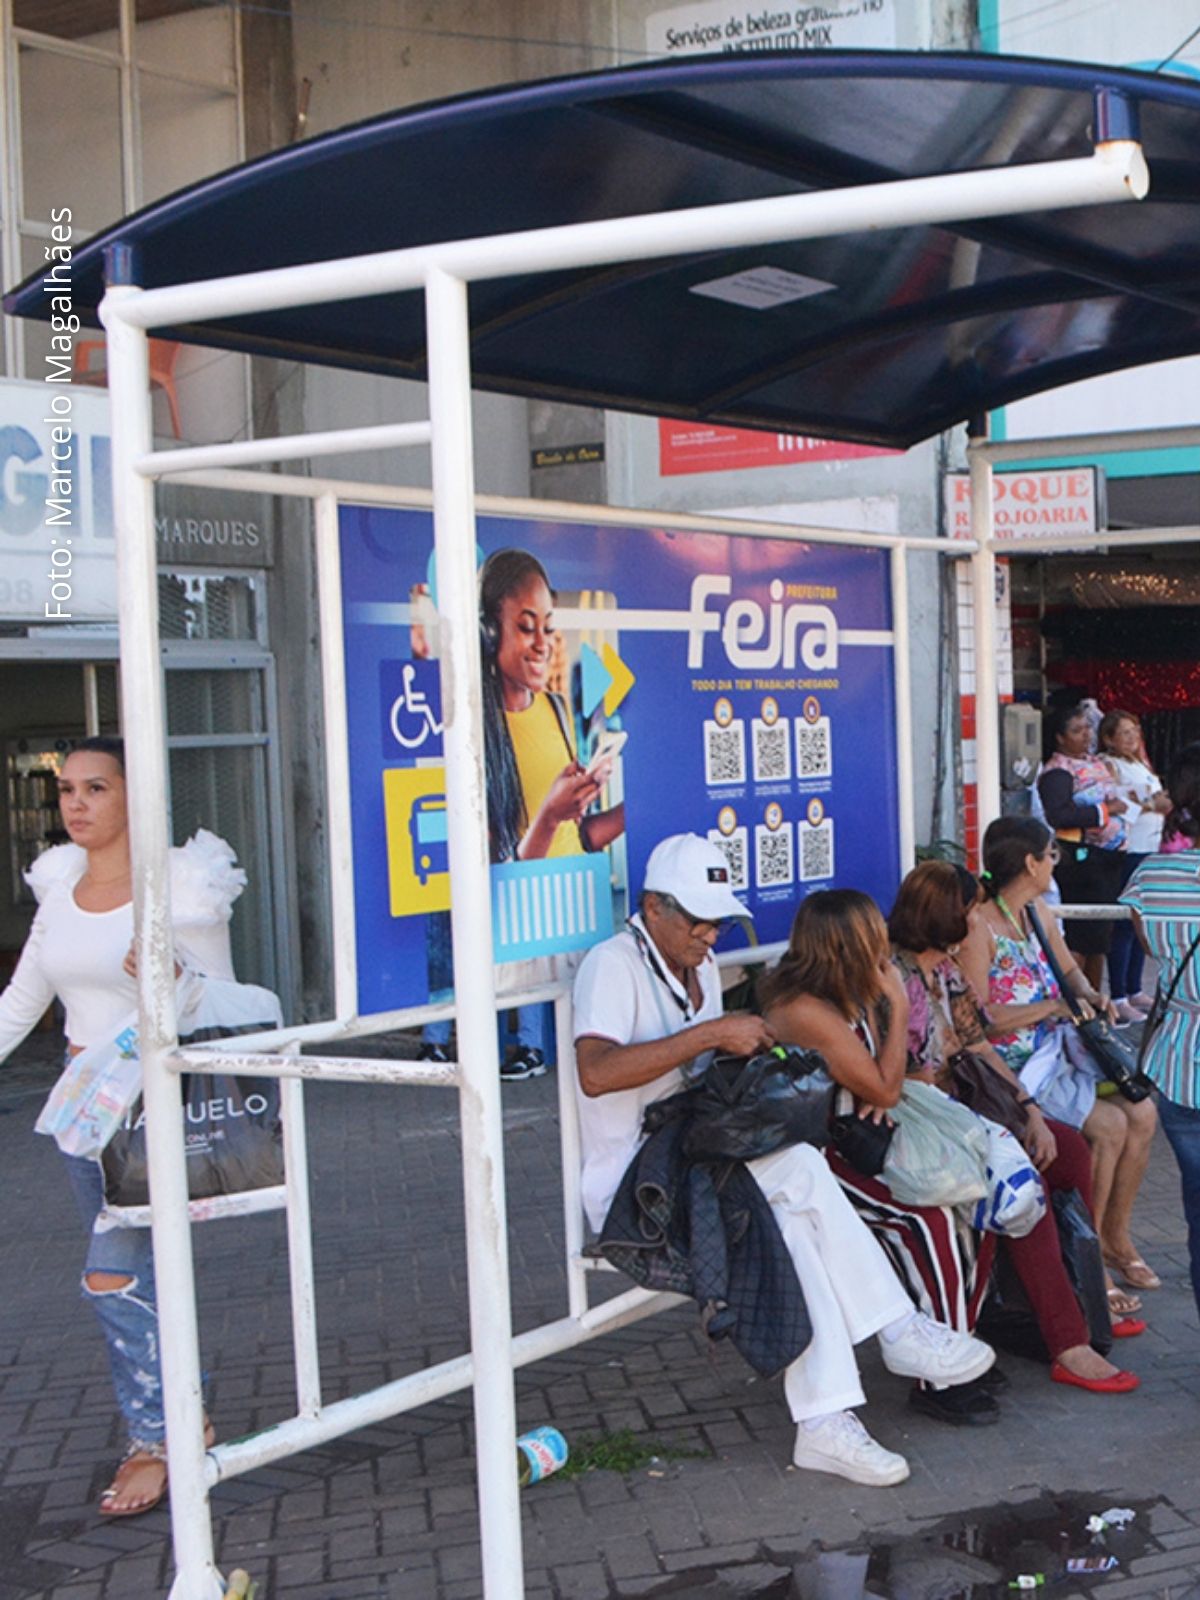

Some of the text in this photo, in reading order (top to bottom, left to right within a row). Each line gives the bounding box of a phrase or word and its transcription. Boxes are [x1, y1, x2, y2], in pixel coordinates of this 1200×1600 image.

[666, 21, 721, 50] Serviços
[725, 17, 743, 38] de
[746, 10, 791, 34] beleza
[802, 26, 832, 47] MIX
[955, 505, 1089, 527] ROJOARIA
[154, 519, 260, 547] MARQUES
[687, 573, 838, 671] feira
